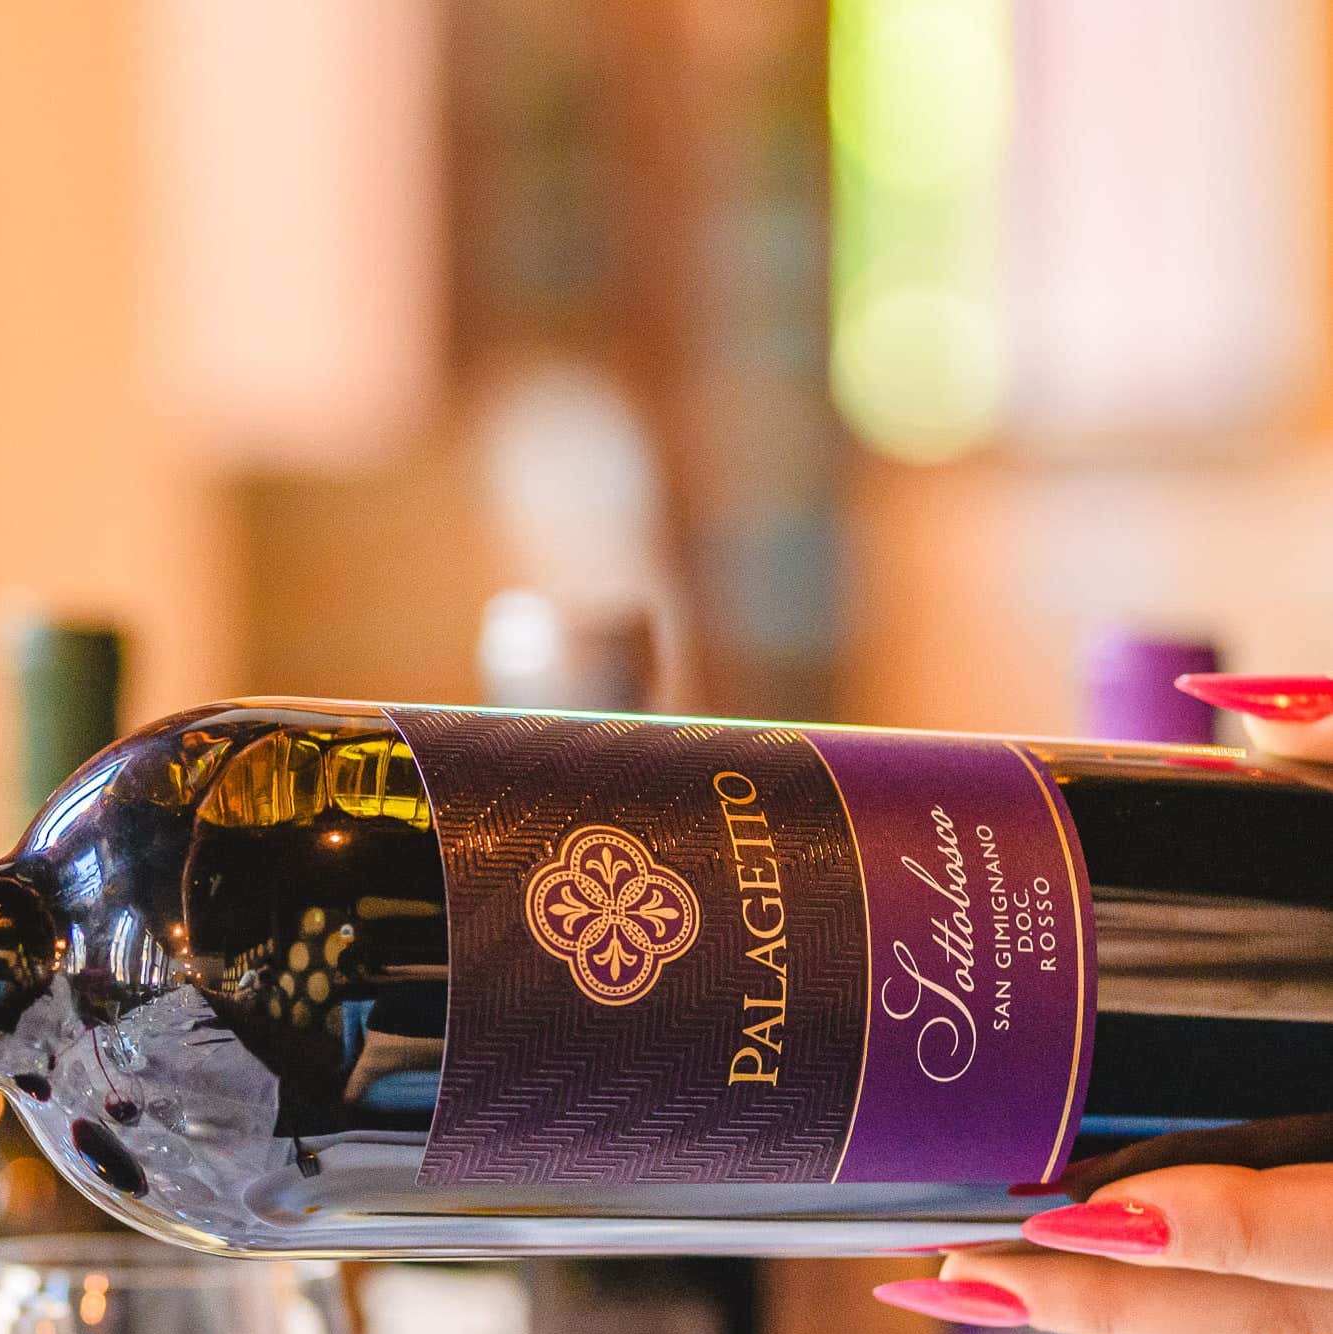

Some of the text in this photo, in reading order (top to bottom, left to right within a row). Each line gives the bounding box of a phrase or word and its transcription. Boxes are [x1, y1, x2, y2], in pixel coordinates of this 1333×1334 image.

[713, 771, 788, 1086] PALAGETTO
[882, 804, 977, 1082] Sottobosco
[976, 825, 1012, 1031] SAN GIMIGNANO
[1014, 888, 1034, 953] D.O.C.
[1033, 877, 1057, 971] ROSSO
